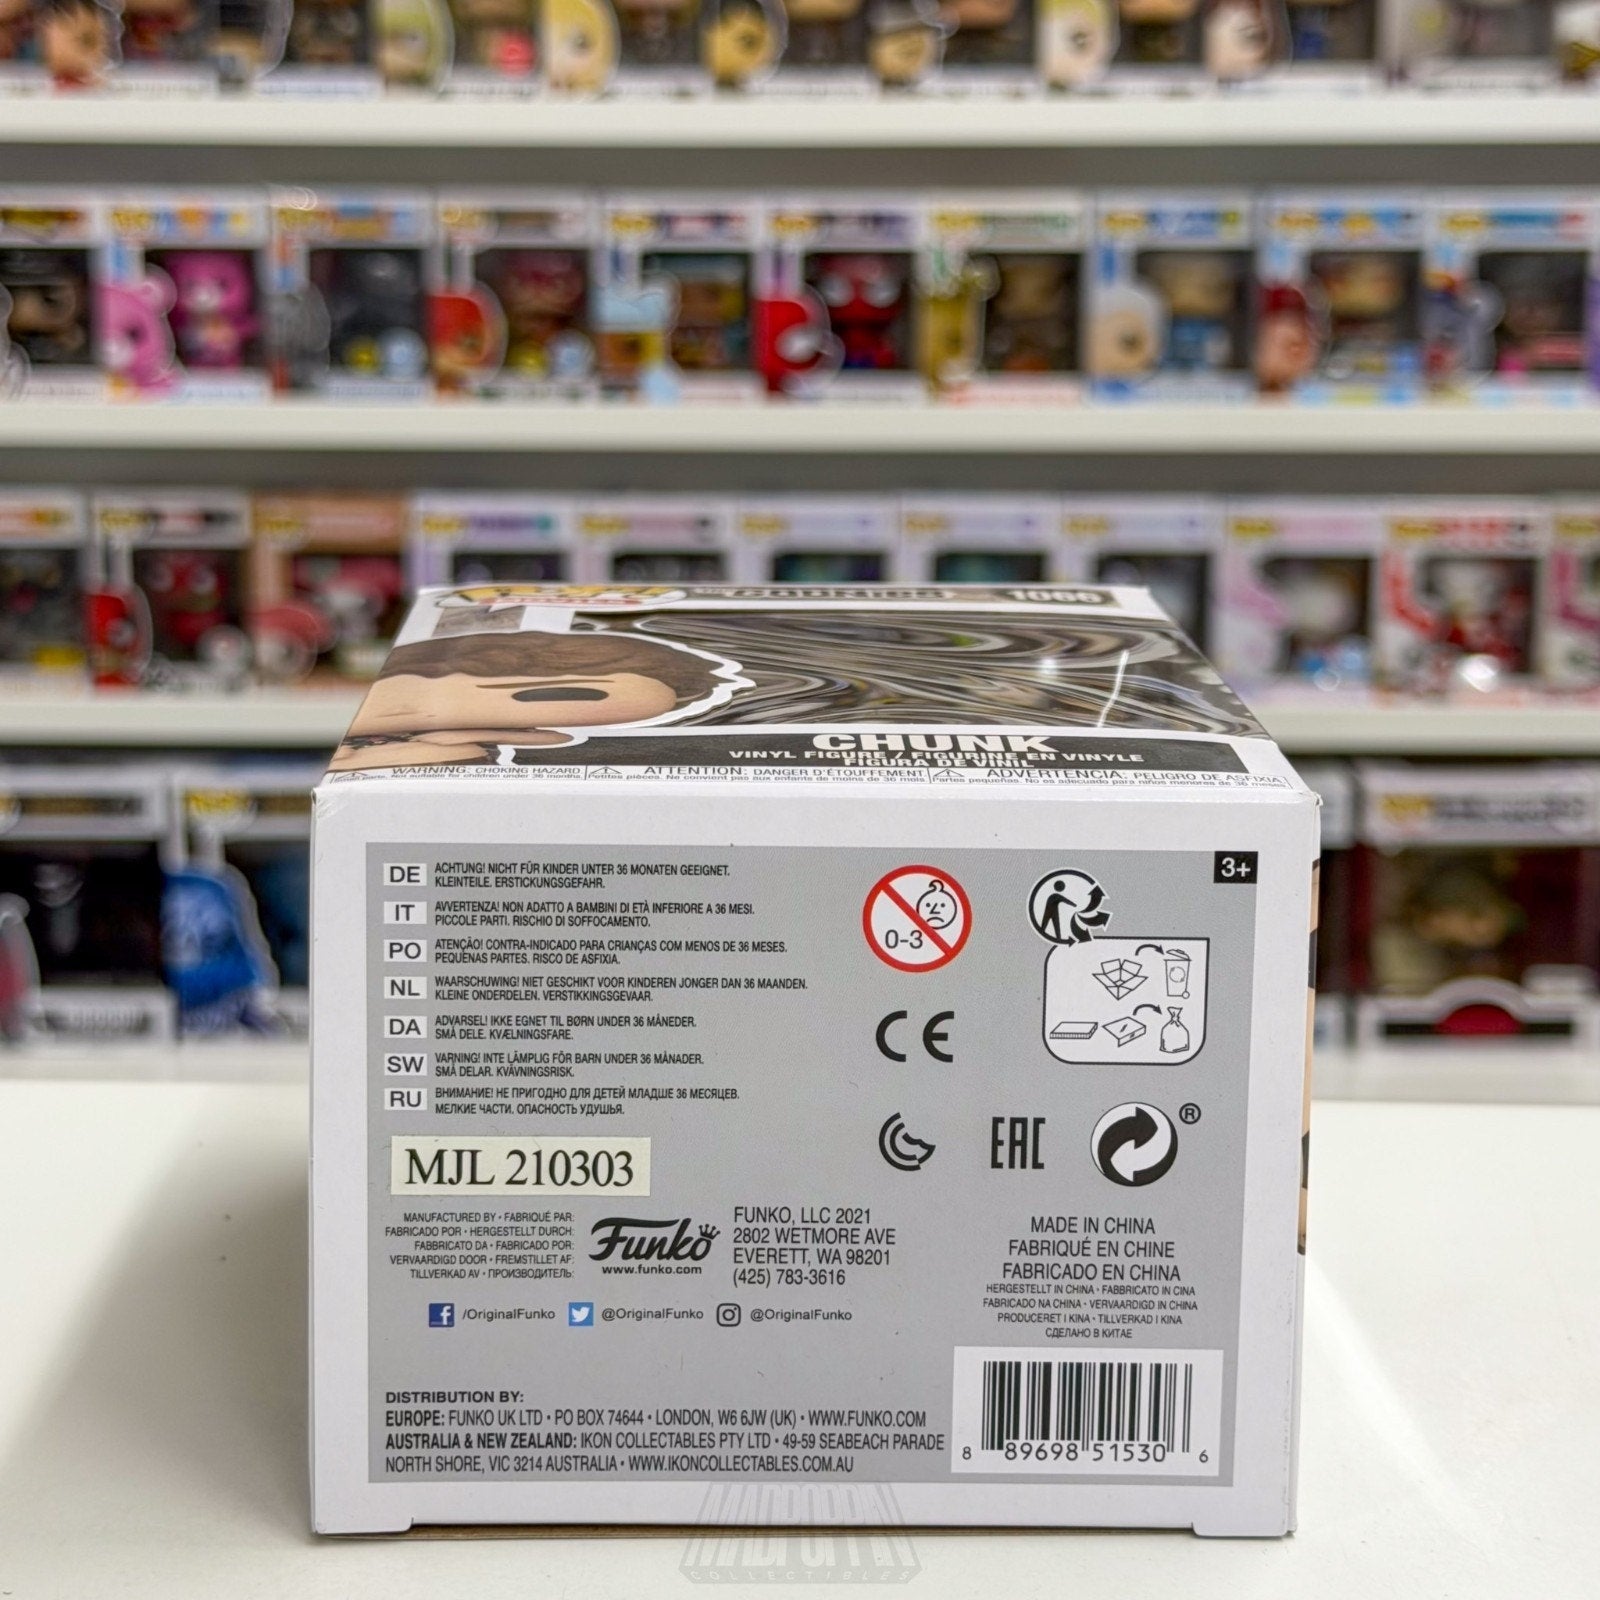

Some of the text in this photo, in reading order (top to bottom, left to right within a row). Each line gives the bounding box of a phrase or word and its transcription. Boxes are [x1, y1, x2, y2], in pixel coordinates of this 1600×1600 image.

[812, 735, 1059, 752] CHUNK
[728, 751, 797, 759] VINYL
[804, 751, 885, 759] FIGURE
[911, 752, 1018, 760] FIGURINE
[1027, 753, 1056, 761] EN
[1062, 753, 1145, 762] VINYLE
[845, 759, 1035, 768] FIGURA DE VINIL
[392, 766, 470, 774] WARNING:
[644, 766, 747, 775] ATTENTION:
[987, 769, 1127, 779] ADVERTENCIA:
[1134, 772, 1196, 781] PELIGRO
[390, 866, 420, 882] DE
[434, 862, 485, 873] ACHTUNG!
[488, 862, 517, 873] NICHT
[542, 863, 578, 874] KINDER
[581, 863, 614, 874] UNTER
[616, 863, 627, 875] 36
[630, 864, 677, 875] MONATEN
[1221, 857, 1252, 878] 3+
[395, 904, 414, 921] IT
[885, 929, 924, 950] 0-3
[389, 942, 421, 959] PO
[390, 979, 419, 995] NL
[434, 976, 519, 987] WAARSCHUWING!
[522, 976, 543, 987] NIET
[546, 976, 594, 987] GESCHIKT
[597, 976, 624, 987] VOOR
[627, 977, 676, 988] KINDEREN
[679, 977, 718, 988] JONGER
[721, 977, 741, 988] DAN
[744, 978, 754, 988] 36
[435, 989, 468, 1000] KLEINE
[389, 1018, 420, 1035] DA
[435, 1015, 487, 1028] ADVARSEL!
[490, 1015, 512, 1026] IKKE
[515, 1015, 547, 1026] EGNET
[550, 1015, 563, 1026] TIL
[597, 1015, 630, 1026] UNDER
[633, 1016, 644, 1026] 36
[876, 1010, 955, 1063] CE
[387, 1055, 423, 1072] SW
[390, 1090, 421, 1107] RU
[435, 1087, 493, 1098] ВНИМАНИЕ!
[496, 1087, 508, 1098] НЕ
[511, 1087, 566, 1100] ПРИГОДНО
[569, 1087, 590, 1100] ДЛЯ
[592, 1086, 625, 1100] ДЕТЕЙ
[628, 1088, 673, 1100] МЛАДШЕ
[676, 1088, 687, 1098] 36
[435, 1103, 476, 1114] МЕЛКИЕ
[516, 1103, 577, 1114] ОПАСНОСТЬ
[991, 1117, 1046, 1169] EAC
[405, 1149, 632, 1186] MJL 210303
[403, 1212, 480, 1222] MANUFACTURED
[483, 1212, 495, 1222] BY
[553, 1212, 574, 1221] PAR:
[734, 1206, 869, 1224] FUNKO, LLC 2021
[1031, 1216, 1155, 1233] MADE IN CHINA
[588, 1217, 716, 1261] Funko
[733, 1227, 895, 1244] 2802 WETMORE AVE
[1009, 1237, 1174, 1257] FABRIQUÉ EN CHINE
[733, 1247, 888, 1266] EVERETT, WA 98201
[602, 1264, 701, 1274] www.funko.com
[733, 1268, 845, 1287] (425) 783-3616
[1003, 1263, 1180, 1281] FABRICADO EN CHINA
[462, 1308, 555, 1321] /OriginalFunko
[601, 1308, 703, 1321] @OriginalFunko
[750, 1308, 852, 1322] @OriginalFunko
[1045, 1327, 1132, 1338] СДЕЛАНО В КИТАЕ
[386, 1391, 523, 1403] DISTRIBUTION BY:
[386, 1408, 925, 1428] EUROPE: FUNKO UK LTD PO BOX 74644 LONDON, W6 6JW (UK) WWW.FUNKO.COM
[385, 1431, 944, 1450] AUSTRALIA & NEW ZEALAND: IKON COLLECTABLES PTY LTD 49-59 SEABEACH PARADE
[962, 1442, 1209, 1464] 8 89698 51530 6
[386, 1454, 853, 1473] NORTH SHORE, VIC 3214 AUSTRALIA WWW.IKONCOLLECTABLES.COM.AU
